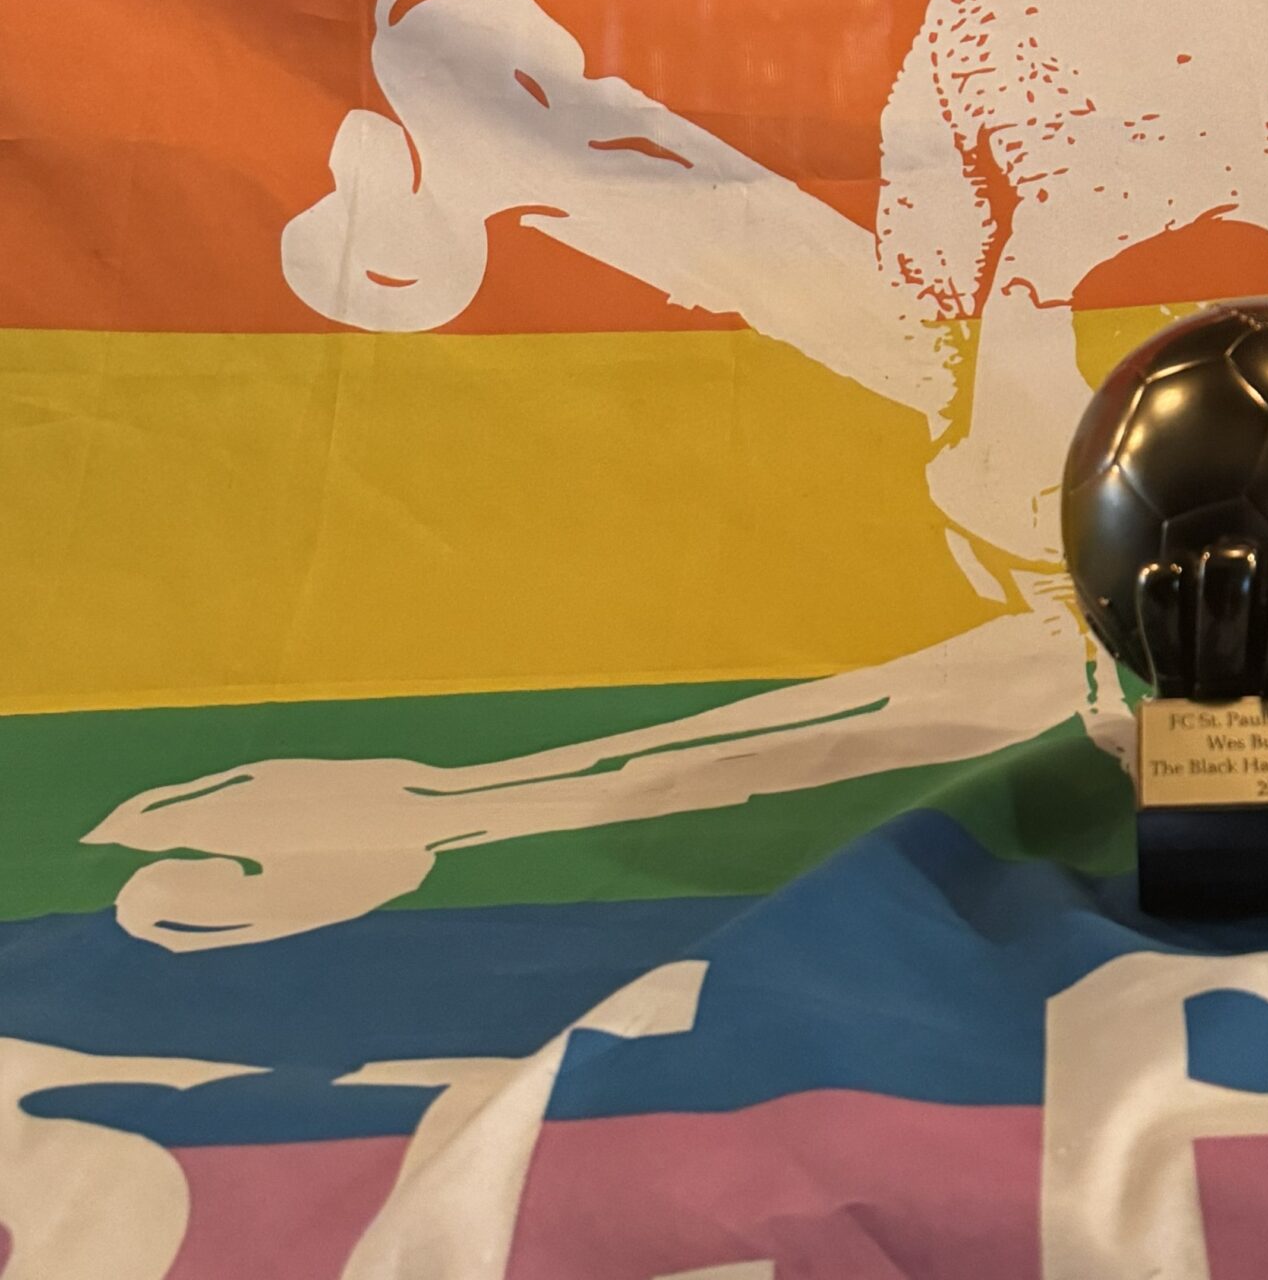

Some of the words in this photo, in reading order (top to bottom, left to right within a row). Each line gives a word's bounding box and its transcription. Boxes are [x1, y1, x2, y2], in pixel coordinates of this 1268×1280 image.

[1168, 712, 1196, 730] FC
[1199, 712, 1222, 729] St.
[1206, 734, 1245, 751] Wes
[1150, 759, 1182, 776] The
[1189, 757, 1239, 775] Black
